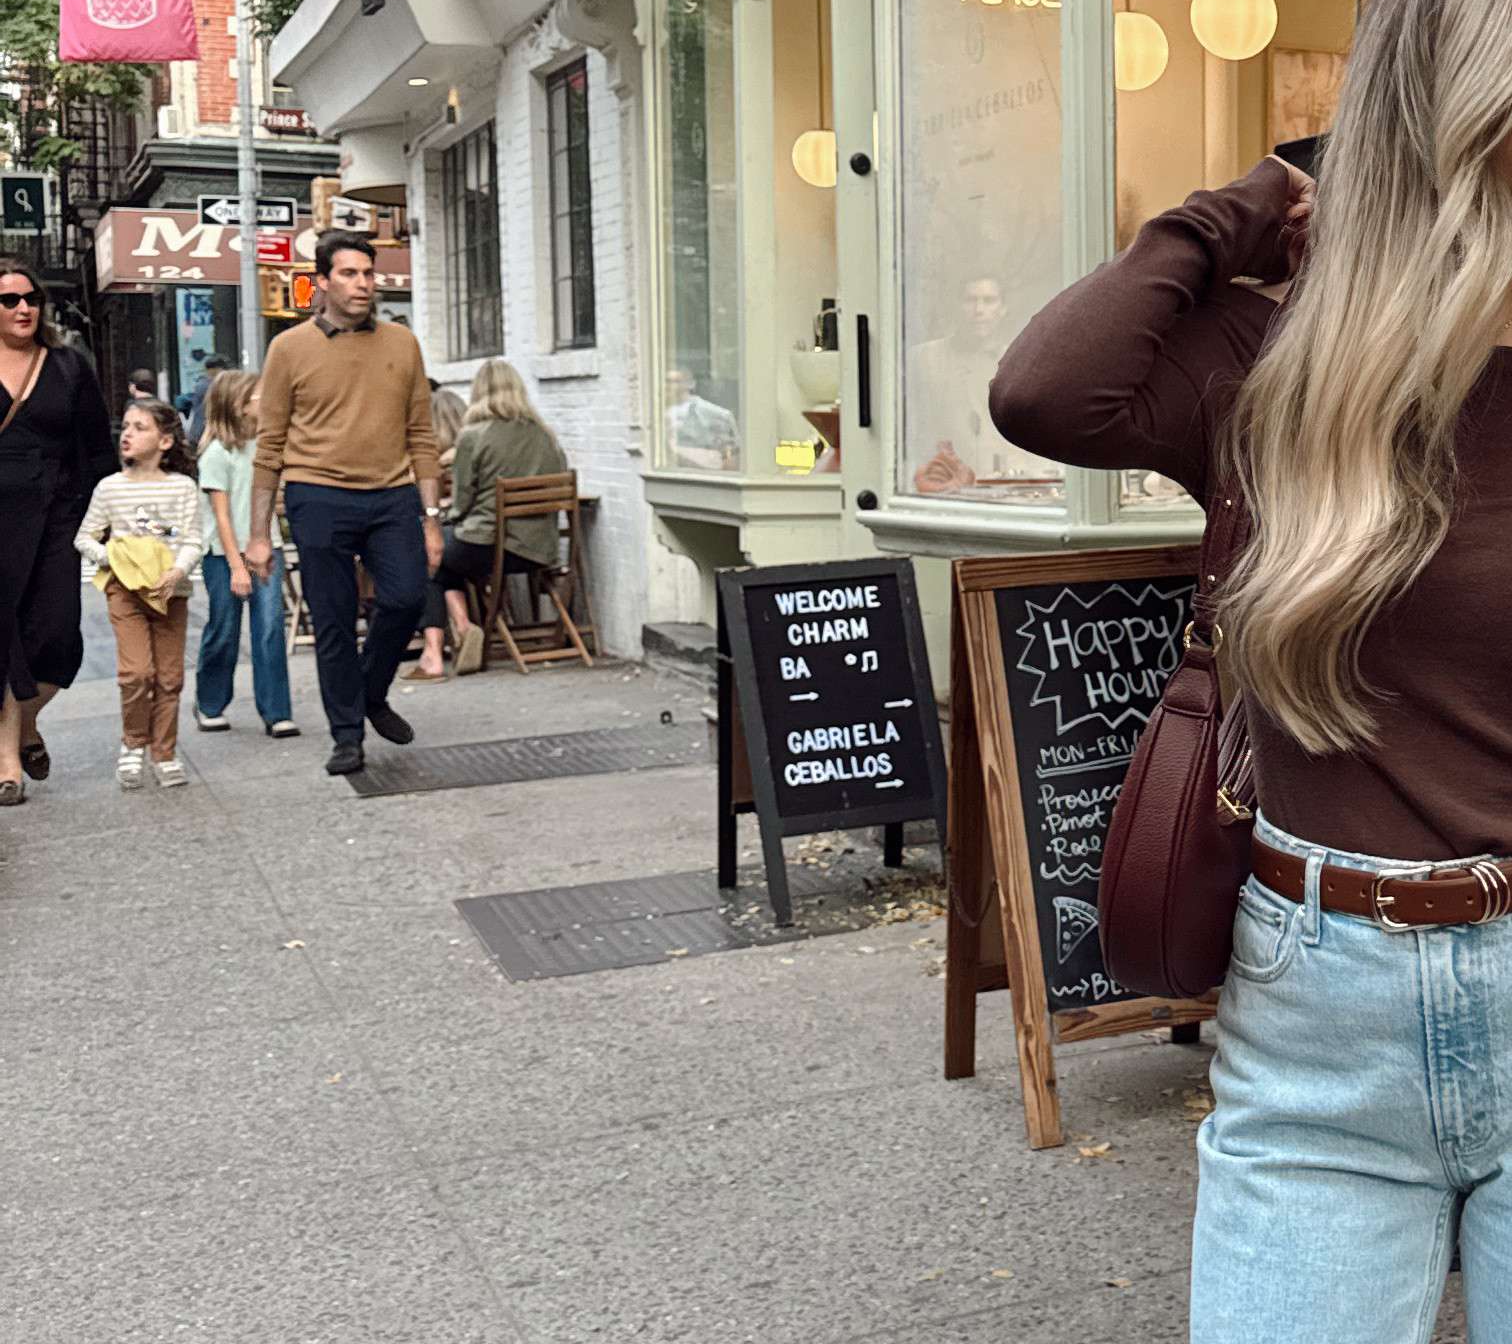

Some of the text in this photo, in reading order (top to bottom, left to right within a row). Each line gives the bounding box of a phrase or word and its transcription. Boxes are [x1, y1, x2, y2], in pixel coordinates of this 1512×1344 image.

[260, 110, 299, 127] Prince
[138, 265, 205, 280] 124
[775, 585, 881, 617] WELCOME
[788, 617, 869, 646] CHARM
[1042, 598, 1184, 672] Happy
[780, 657, 812, 681] BA
[1084, 668, 1169, 709] Hour
[787, 720, 900, 754] GABRIELA
[784, 752, 893, 787] CEBALLOS
